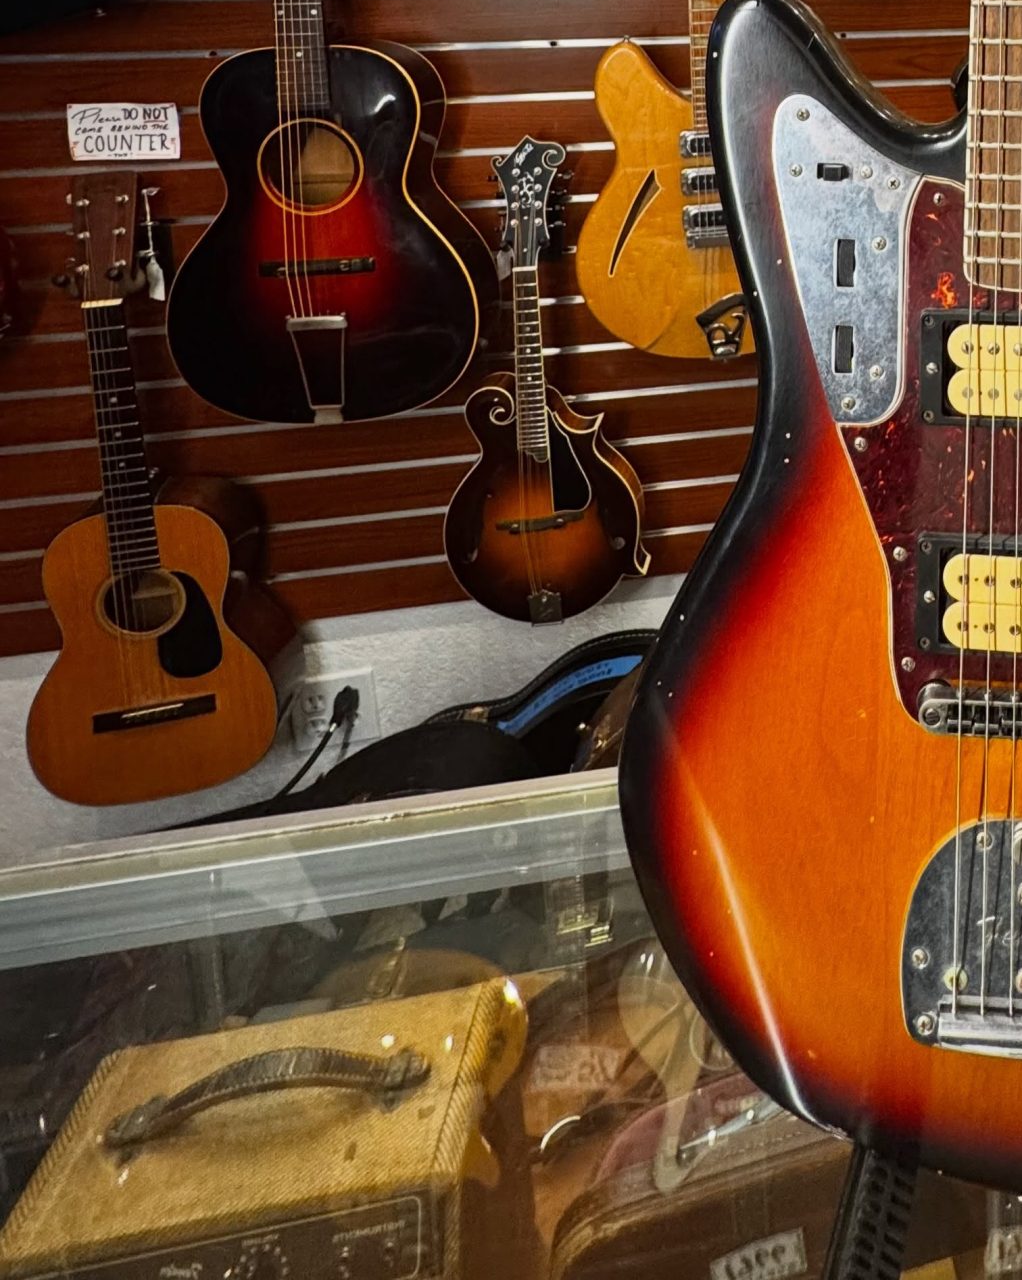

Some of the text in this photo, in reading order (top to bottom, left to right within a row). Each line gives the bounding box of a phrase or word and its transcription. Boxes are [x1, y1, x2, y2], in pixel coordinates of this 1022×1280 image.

[121, 107, 140, 121] DO
[142, 106, 171, 121] NOT
[83, 133, 171, 154] COUNTER
